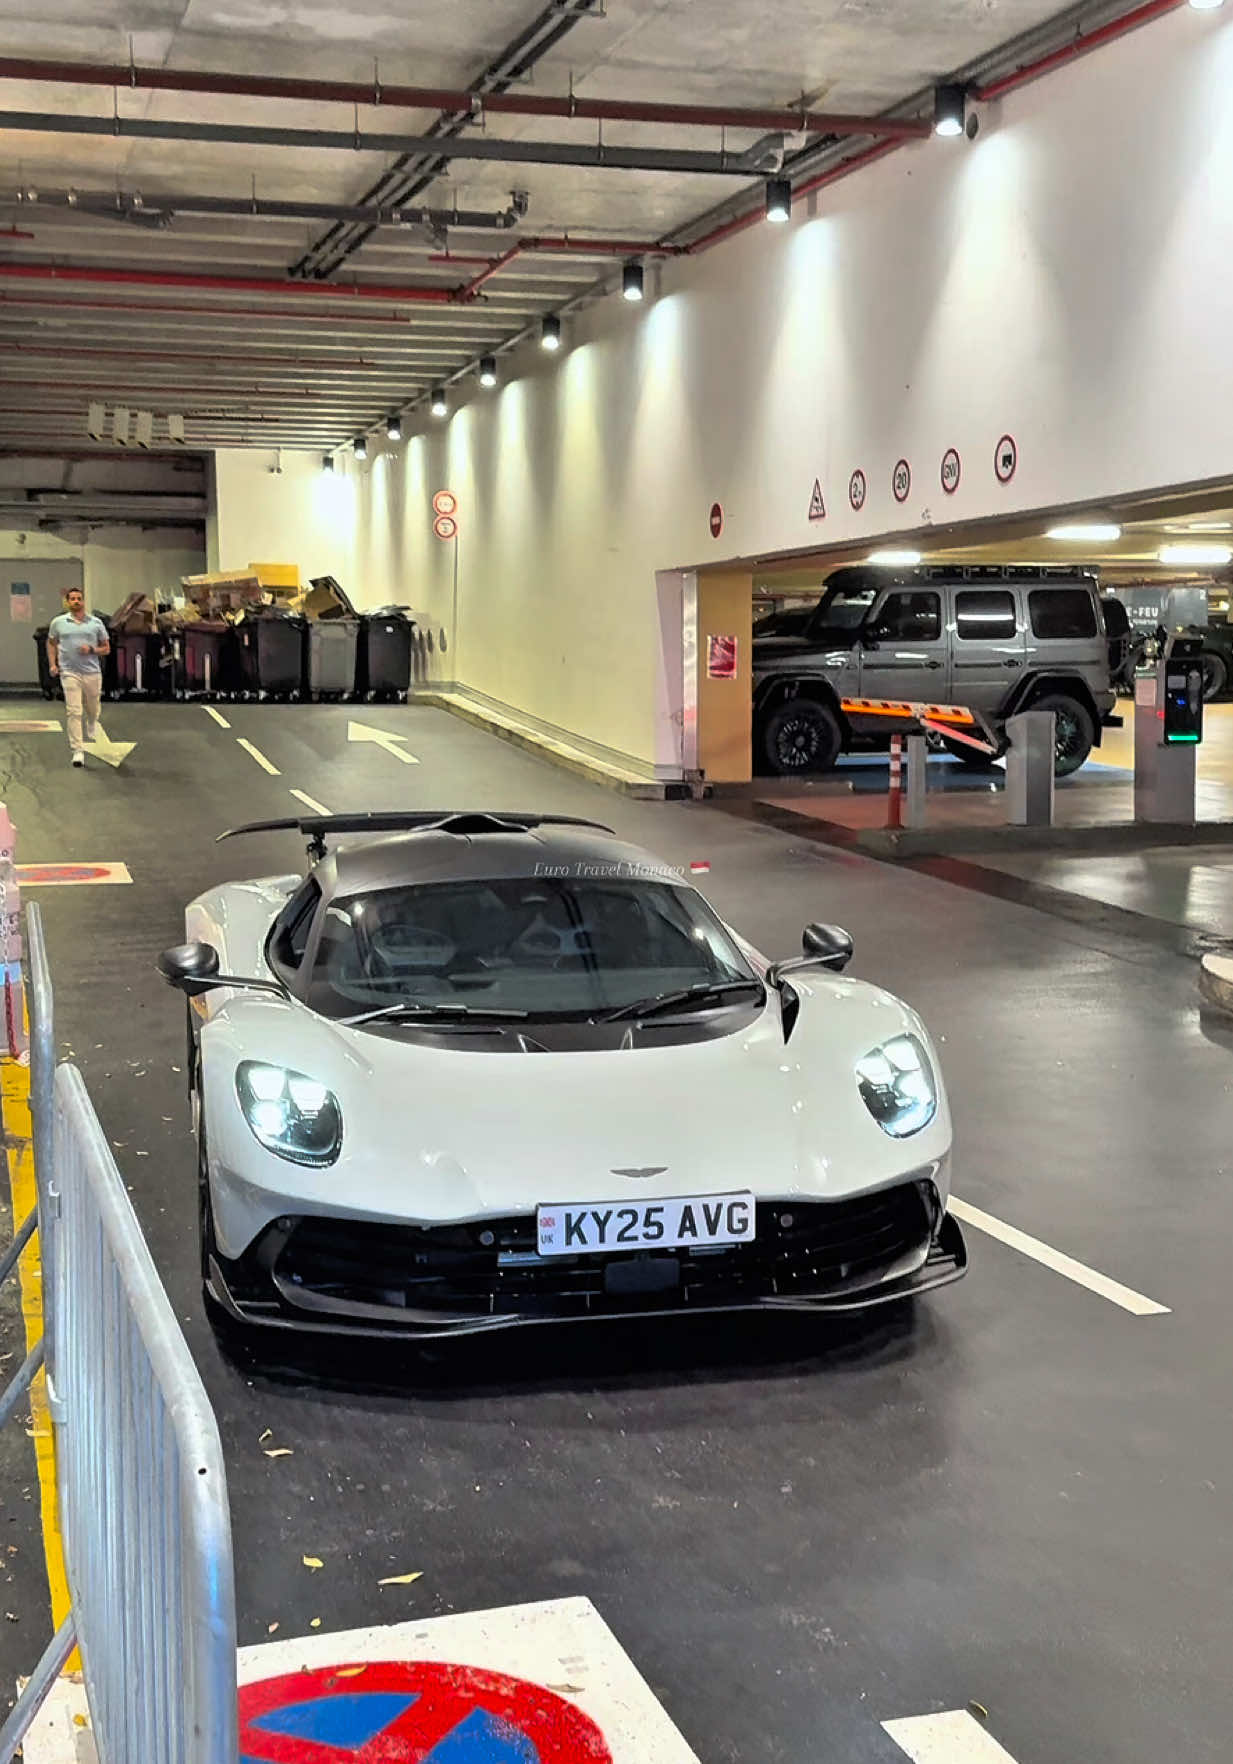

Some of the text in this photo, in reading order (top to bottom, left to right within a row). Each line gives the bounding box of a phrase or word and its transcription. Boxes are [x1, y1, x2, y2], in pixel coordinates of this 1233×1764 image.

[896, 472, 907, 490] 20
[564, 1201, 749, 1247] KY25 AVG
[540, 1234, 554, 1245] UK
